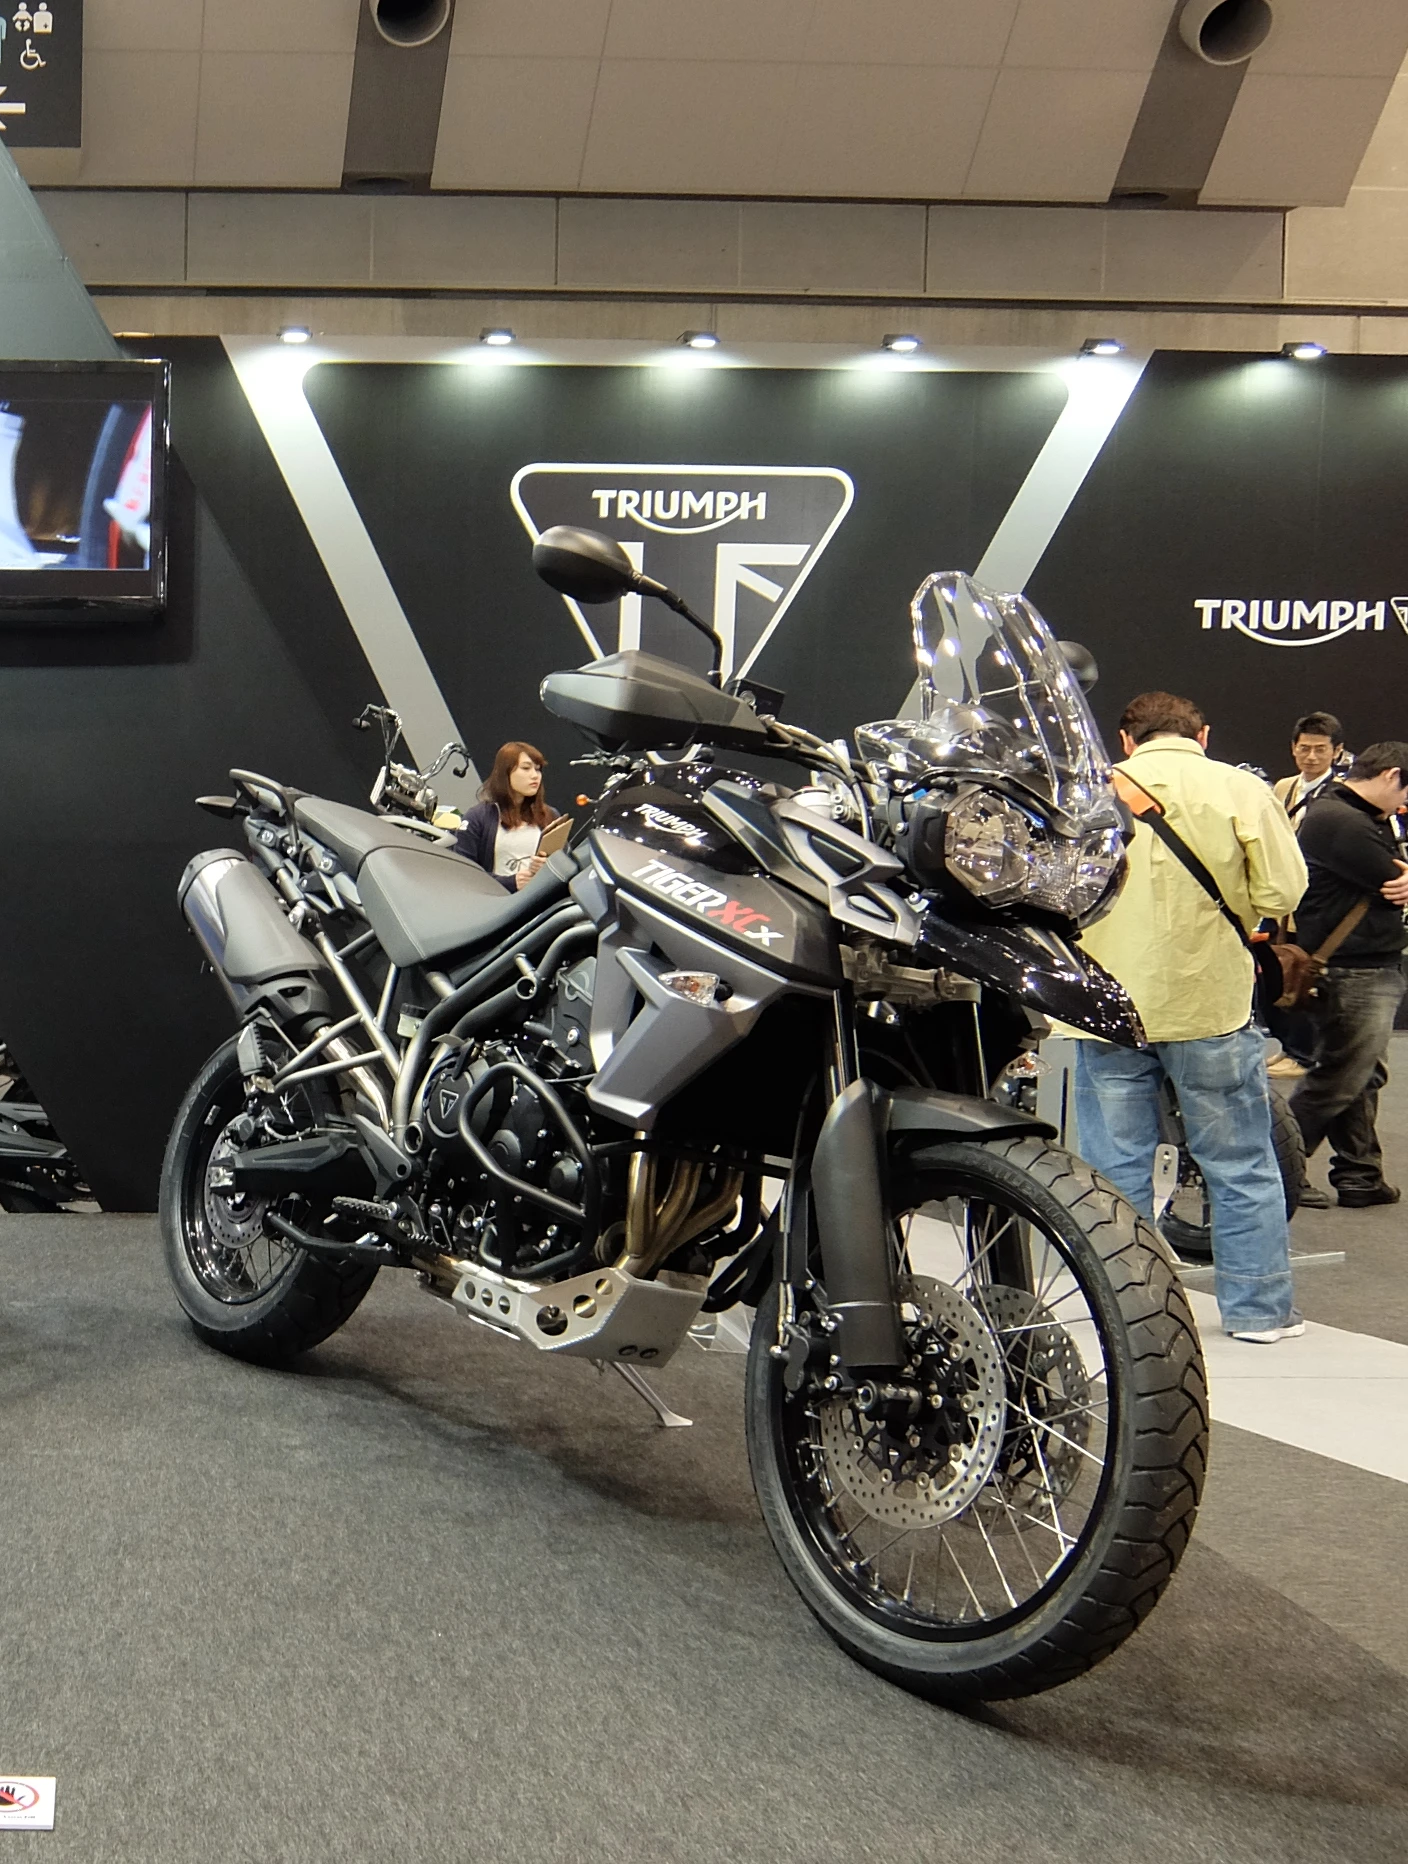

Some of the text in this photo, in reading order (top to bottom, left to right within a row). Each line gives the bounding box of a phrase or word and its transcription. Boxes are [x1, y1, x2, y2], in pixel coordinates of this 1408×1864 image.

[592, 489, 767, 534] TRIUMPH
[1194, 599, 1385, 647] TRIUMPH
[634, 803, 709, 841] TRIUMPH
